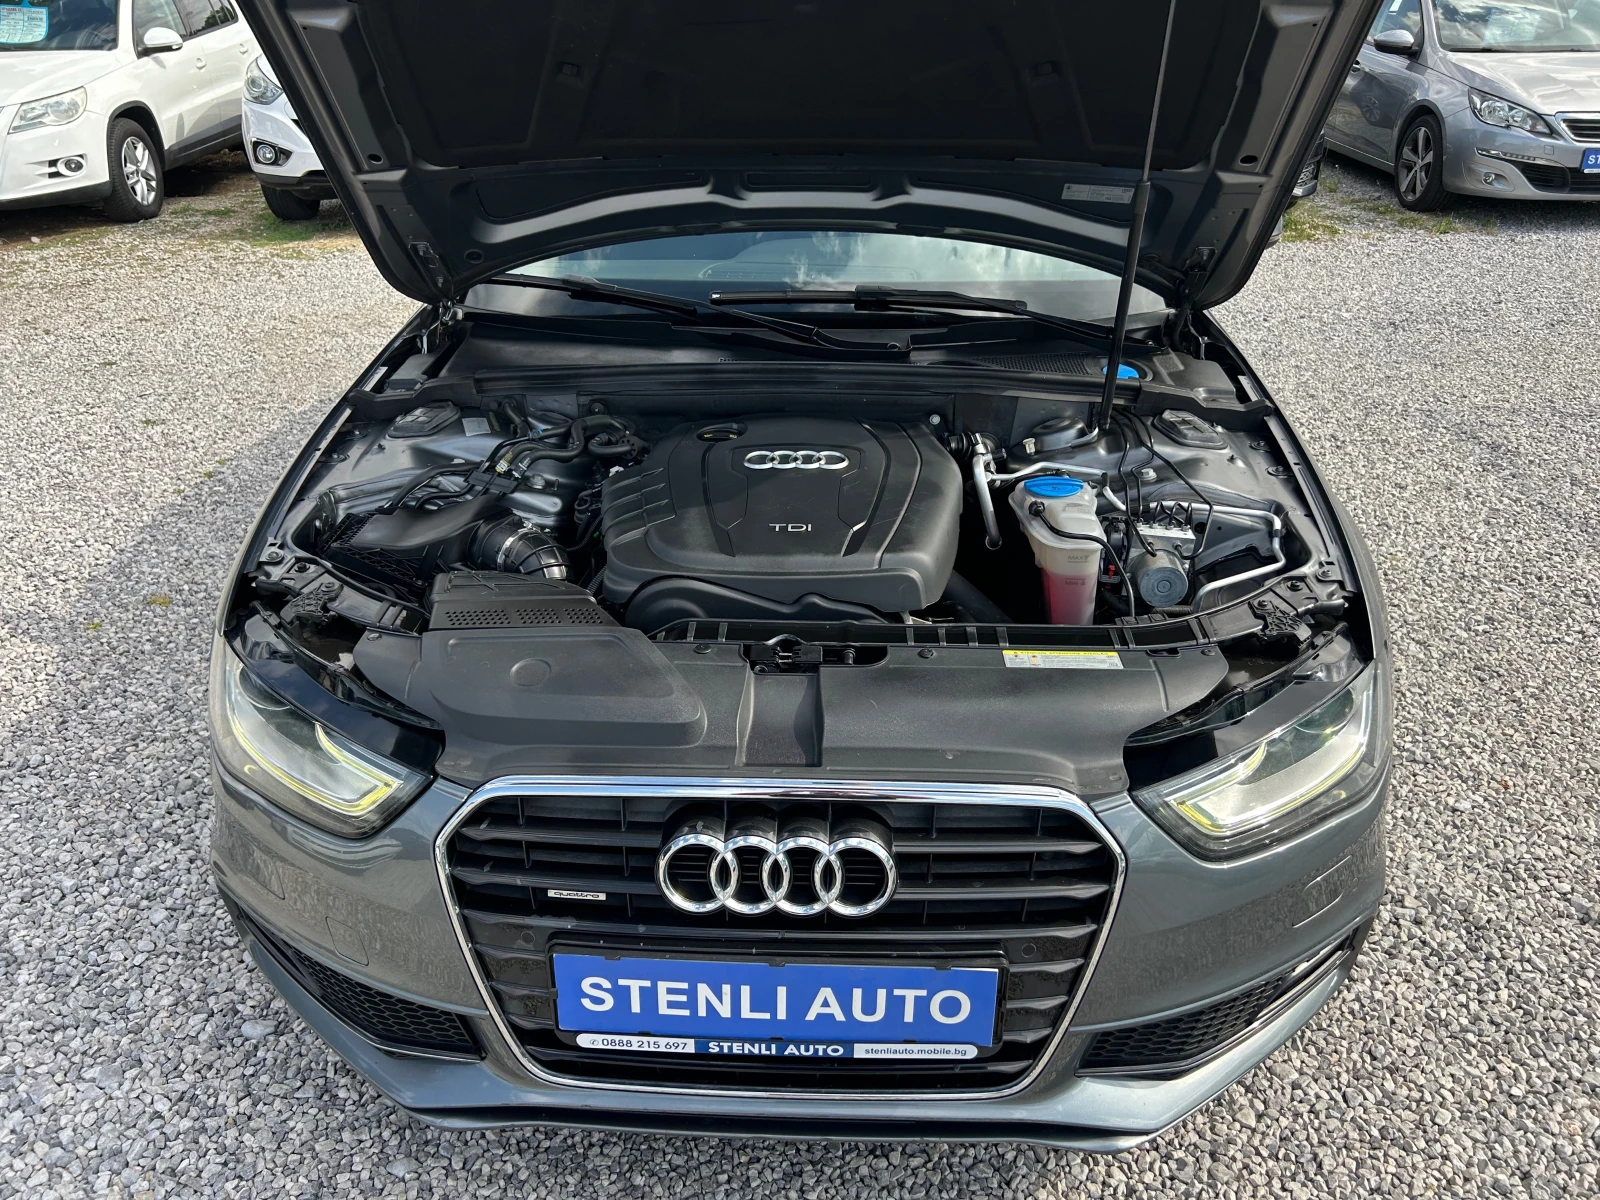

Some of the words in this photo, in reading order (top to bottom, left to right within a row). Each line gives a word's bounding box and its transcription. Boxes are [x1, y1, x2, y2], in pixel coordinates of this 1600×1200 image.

[768, 523, 812, 532] TDI
[553, 891, 600, 899] quattro
[580, 976, 787, 1020] STENLI
[805, 986, 972, 1025] AUTO
[601, 1038, 633, 1048] 0888
[637, 1039, 660, 1049] 215
[664, 1041, 688, 1051] 697
[708, 1042, 776, 1055] STENLI
[783, 1044, 844, 1056] AUTO
[864, 1046, 967, 1057] stenliauto.mobile.bg
